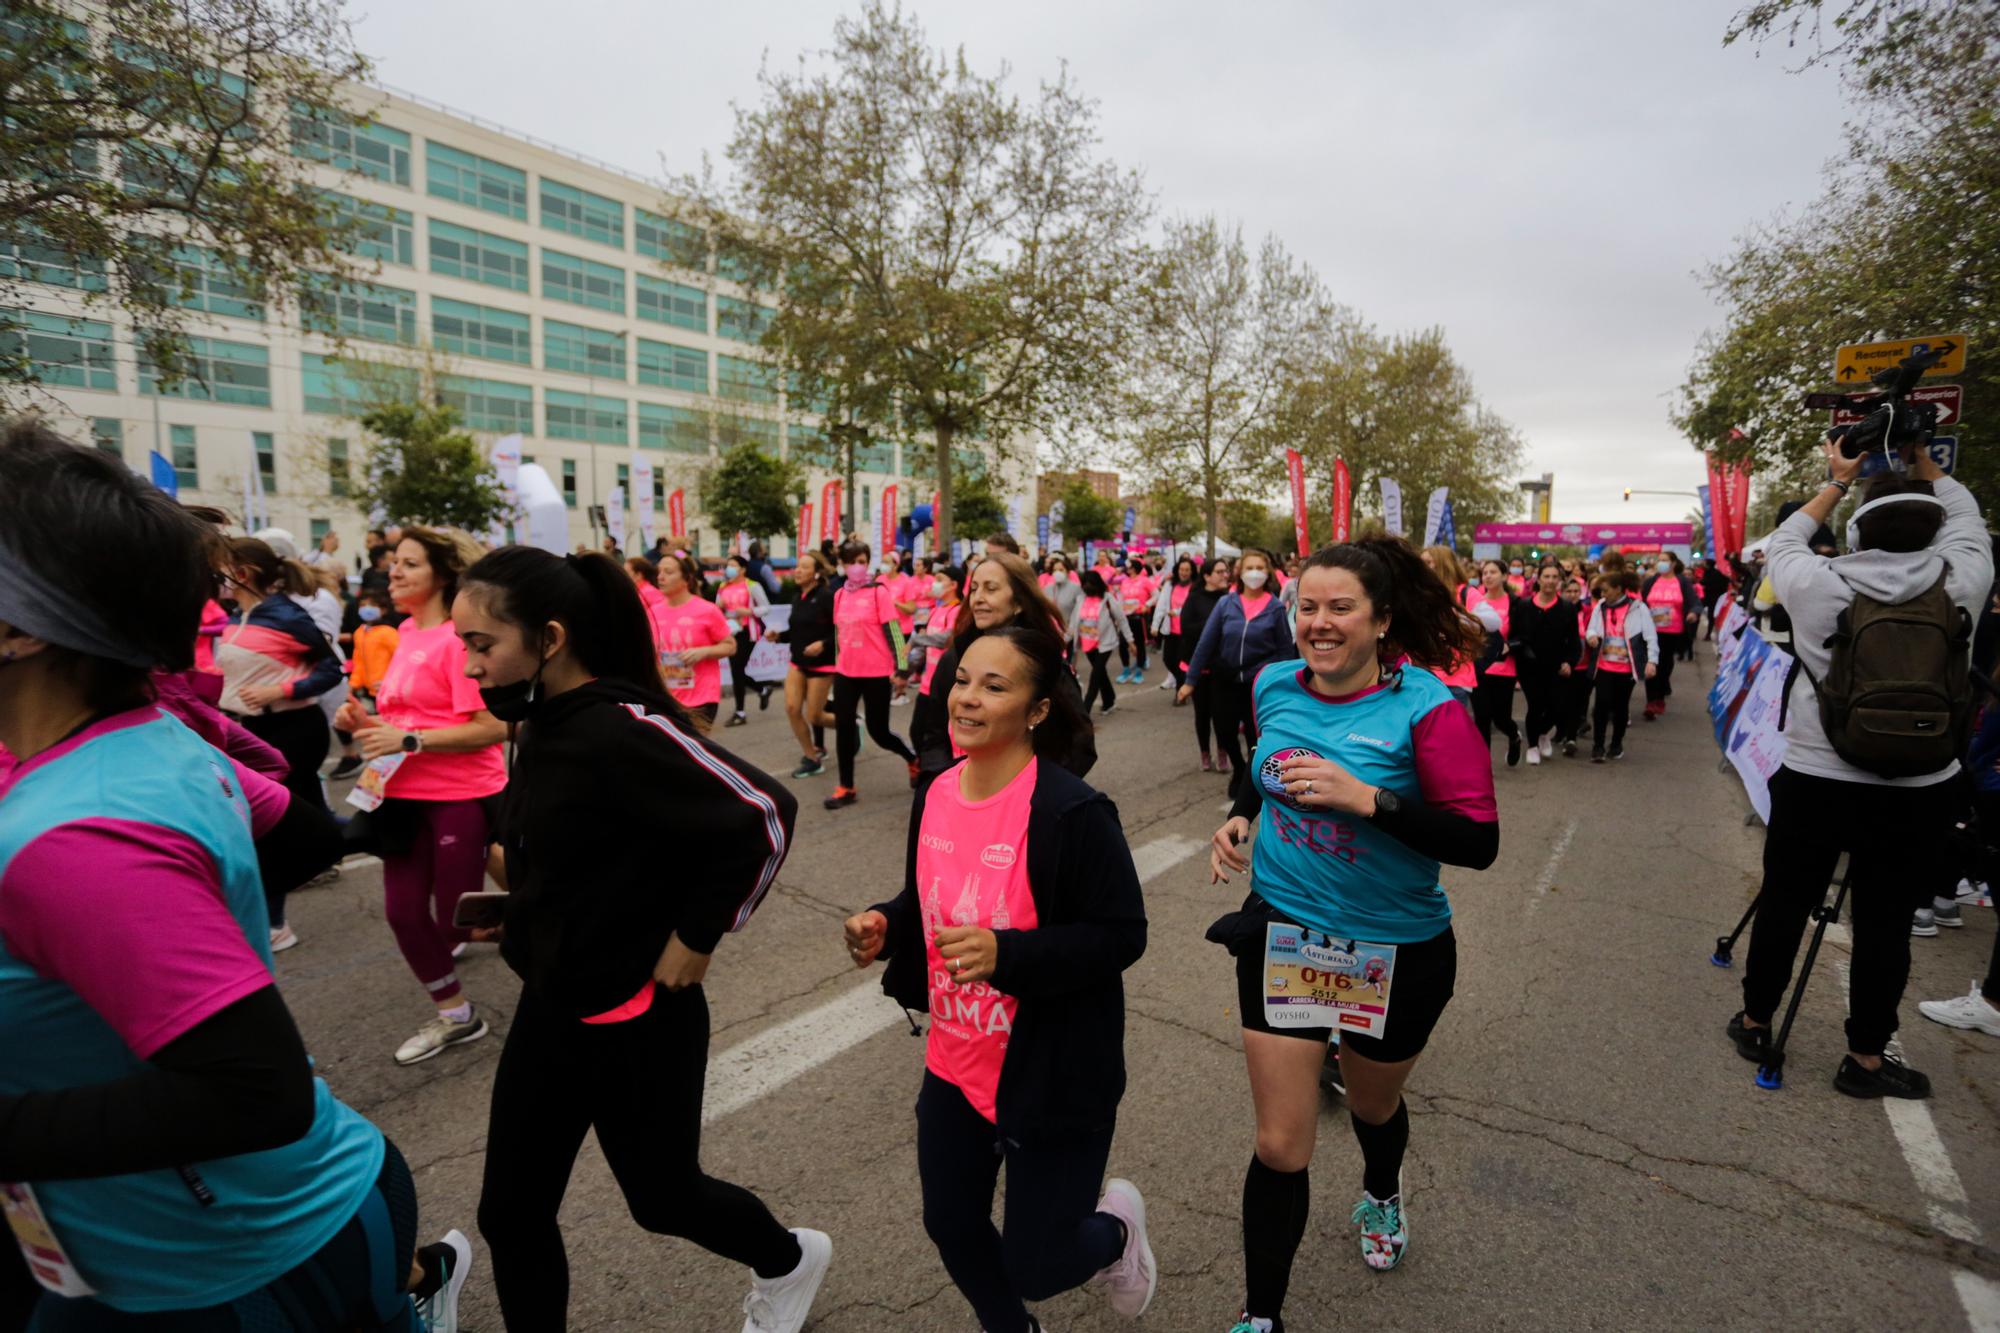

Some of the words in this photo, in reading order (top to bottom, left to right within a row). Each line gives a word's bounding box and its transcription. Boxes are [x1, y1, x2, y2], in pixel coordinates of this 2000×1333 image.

[1855, 348, 1904, 360] Rectorat
[1913, 389, 1959, 401] Superior
[1300, 967, 1352, 991] 016
[1311, 988, 1338, 999] 2512
[1288, 997, 1316, 1005] CARRERA
[930, 987, 1012, 1036] UMA
[1275, 1011, 1310, 1021] OYSHO
